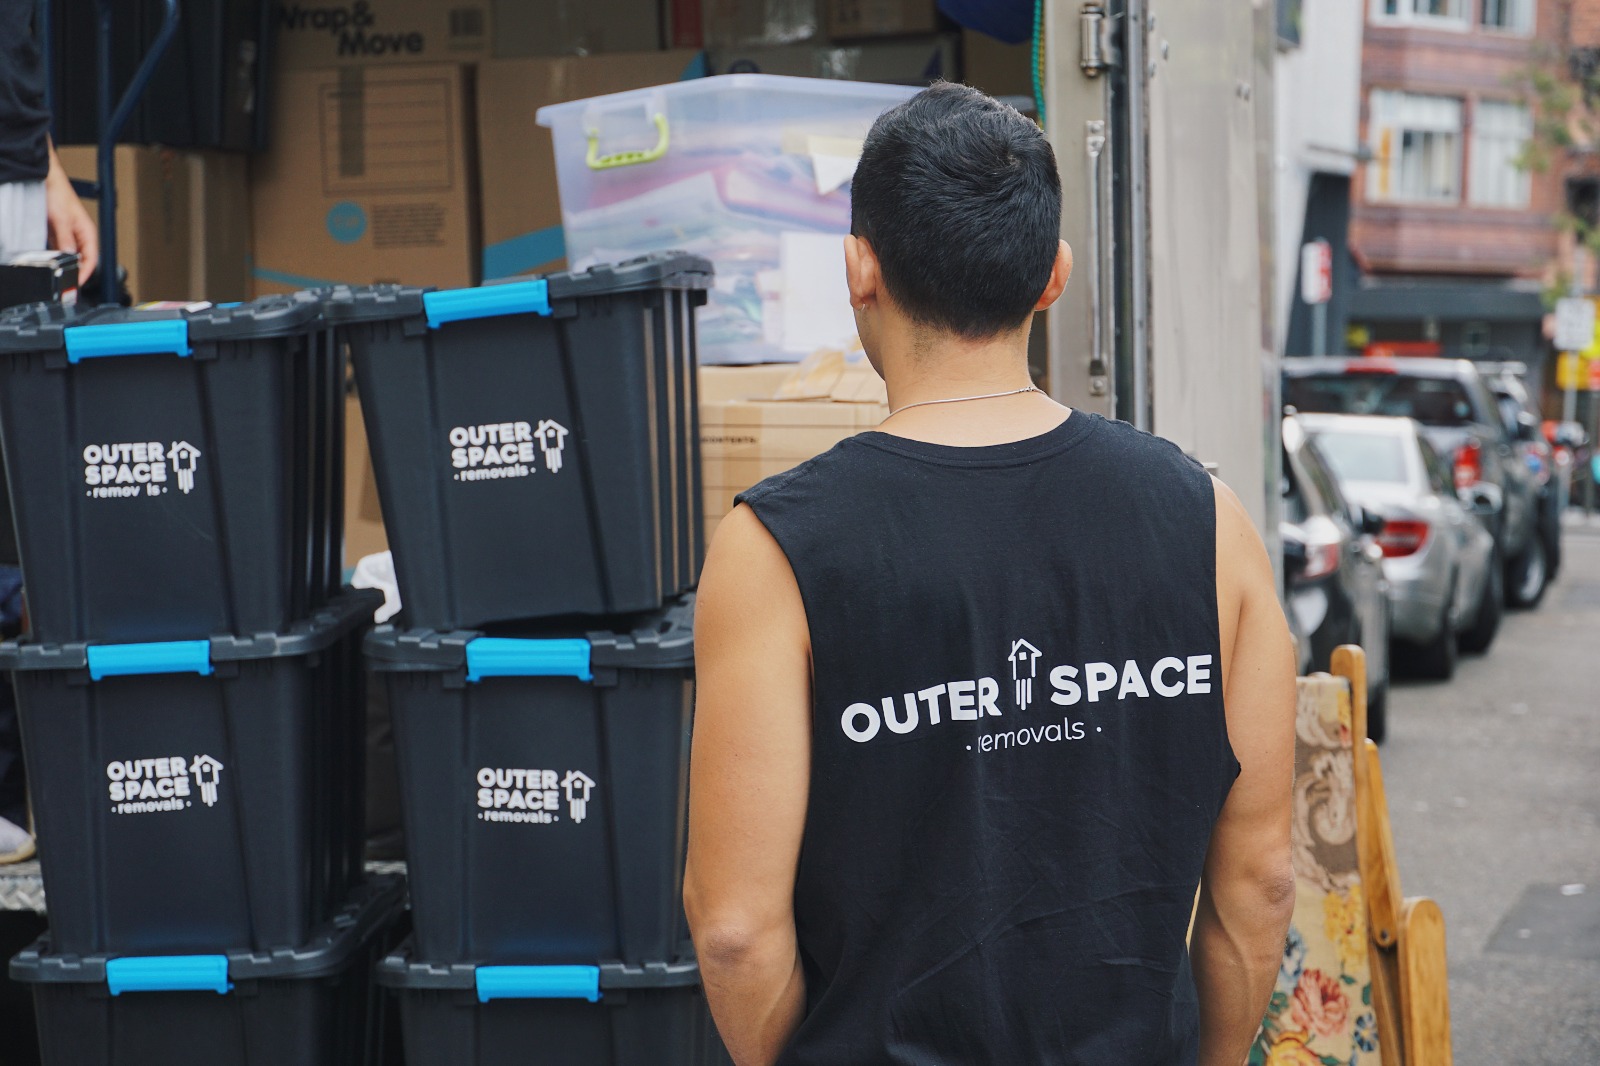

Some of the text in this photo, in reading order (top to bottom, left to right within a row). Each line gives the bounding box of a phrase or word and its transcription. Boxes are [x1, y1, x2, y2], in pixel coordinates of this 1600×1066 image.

[338, 30, 423, 55] Move
[449, 421, 533, 448] OUTER
[83, 441, 166, 465] OUTER
[451, 442, 535, 469] SPACE
[84, 462, 168, 486] SPACE
[460, 463, 530, 482] removals
[92, 482, 161, 499] removls
[840, 654, 1213, 743] OUTER SPACE
[106, 756, 189, 782] OUTER
[476, 767, 560, 790] OUTER
[108, 776, 191, 802] SPACE
[476, 788, 560, 811] SPACE
[117, 796, 185, 815] removals
[482, 809, 553, 824] removals
